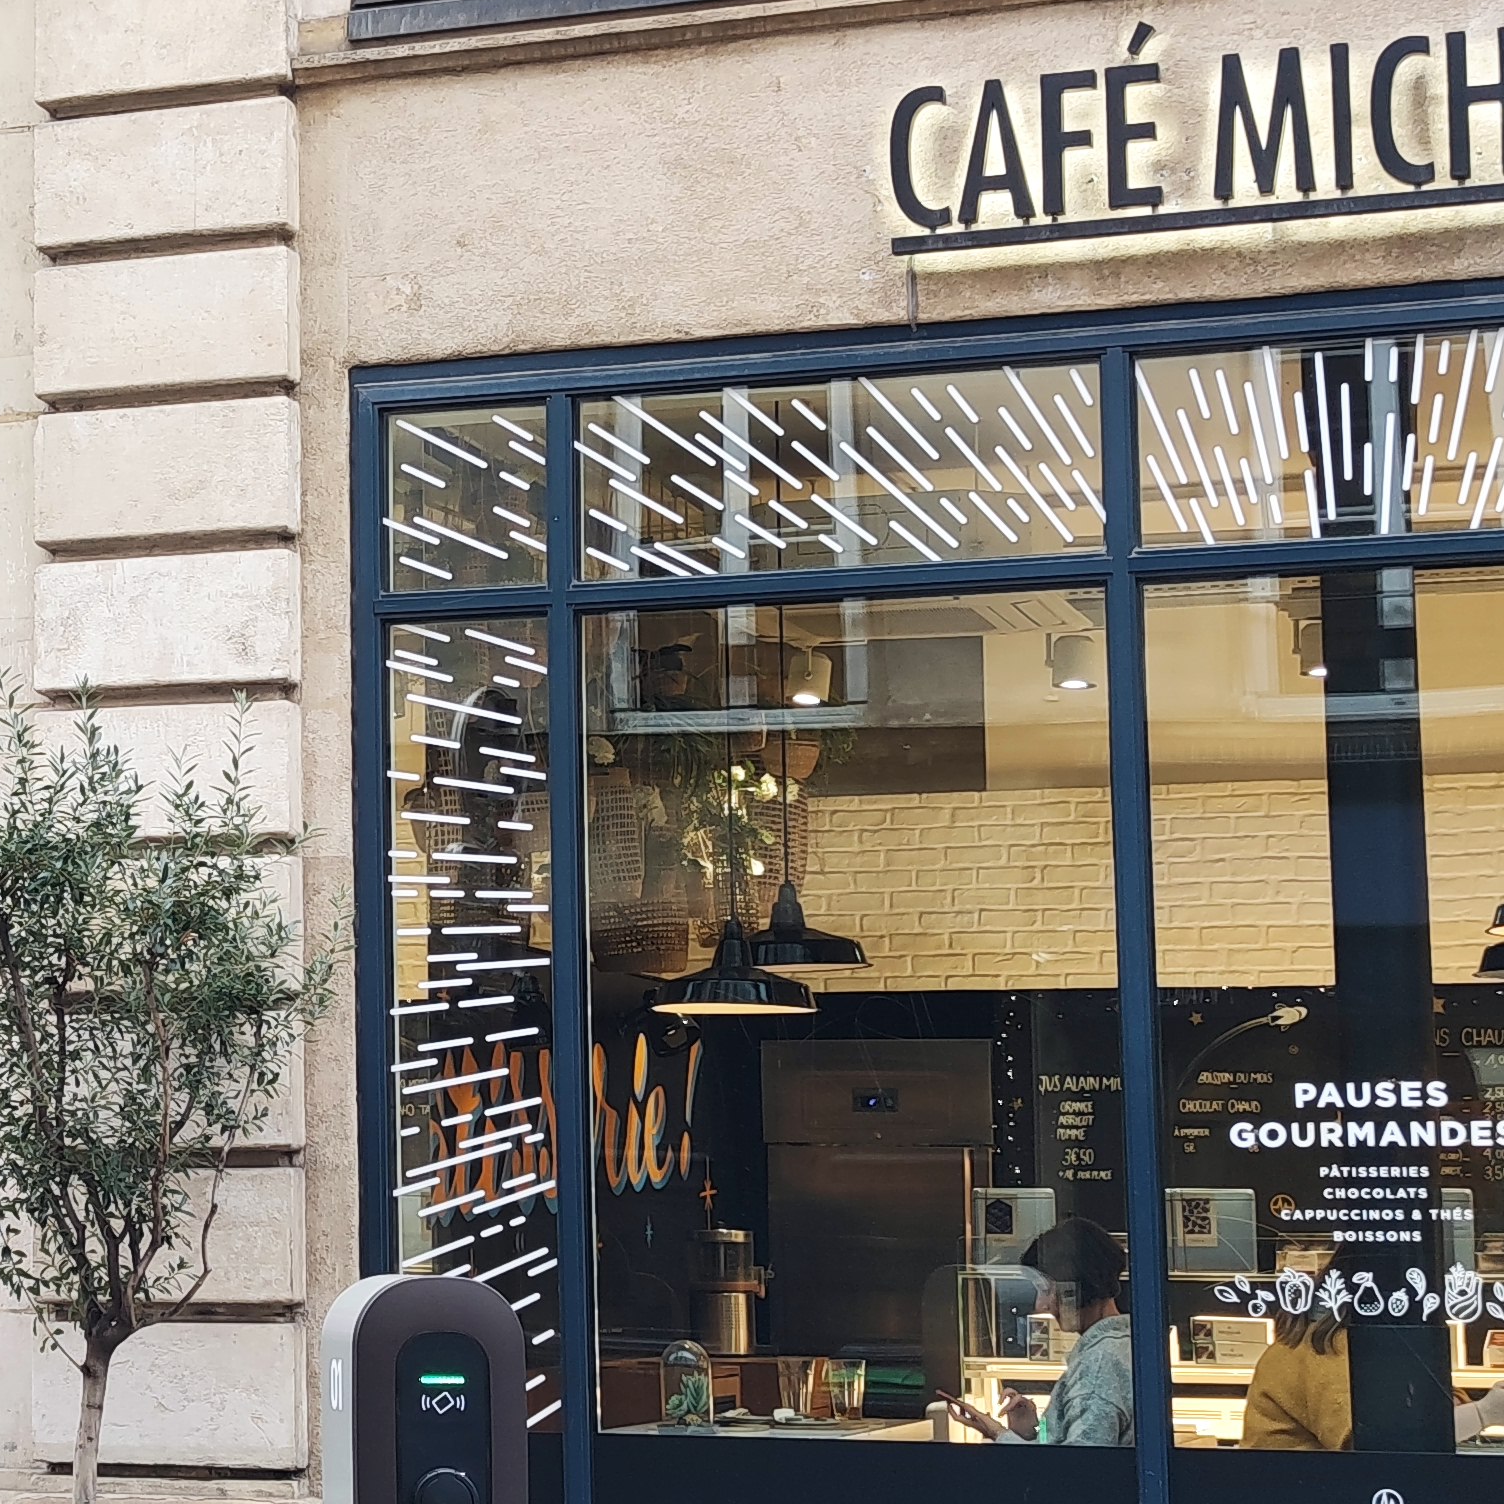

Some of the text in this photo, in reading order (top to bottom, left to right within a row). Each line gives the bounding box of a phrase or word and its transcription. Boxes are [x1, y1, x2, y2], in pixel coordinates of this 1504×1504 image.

[889, 21, 1163, 228] CAFÉ
[1039, 1075, 1061, 1095] JUS
[1063, 1076, 1099, 1092] ALAIN
[1236, 1072, 1248, 1083] DU
[1250, 1072, 1273, 1084] MOIS
[1294, 1081, 1449, 1108] PAUSES
[1179, 1098, 1261, 1113] CHOCOLAT CHAUD
[1319, 1164, 1430, 1178] PÂTISSERIES
[1322, 1187, 1428, 1199] CHOCOLATS
[1280, 1206, 1474, 1220] CAPPUCCINOS & THÉS
[1333, 1231, 1422, 1242] BOISSONS
